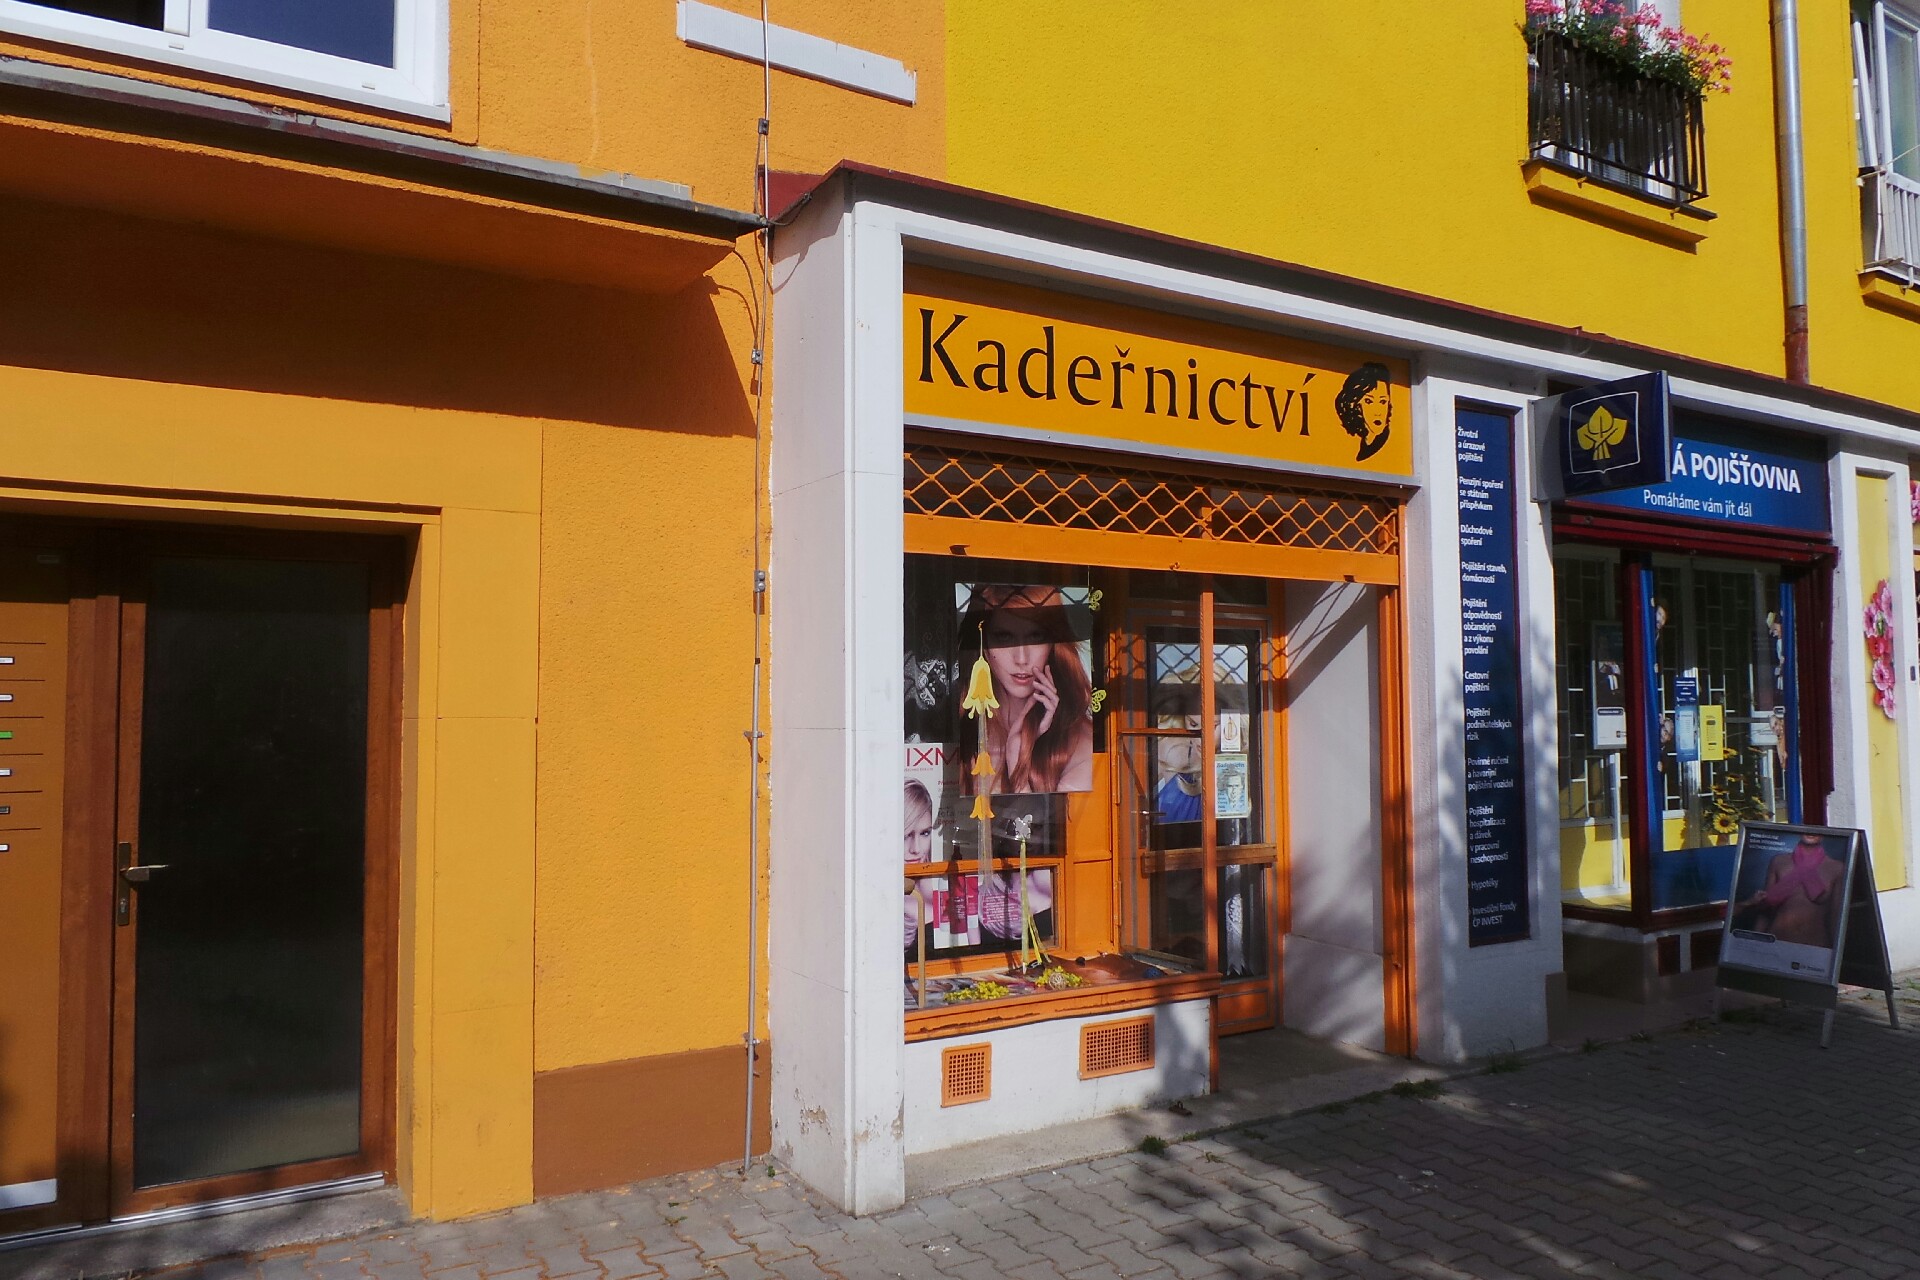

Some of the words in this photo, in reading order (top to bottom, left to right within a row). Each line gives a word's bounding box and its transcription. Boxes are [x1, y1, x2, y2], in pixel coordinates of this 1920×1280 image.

[917, 307, 1316, 437] Kadeřnictví
[1457, 425, 1479, 439] Životní
[1457, 441, 1462, 449] a
[1463, 439, 1486, 451] úrazové
[1458, 452, 1484, 463] pojištění
[1690, 452, 1802, 494] POJIŠŤOVNA
[1459, 476, 1482, 488] Penzijní
[1482, 479, 1504, 489] spoření
[1467, 489, 1489, 499] státním
[1459, 499, 1493, 511] příspěvkem
[1643, 489, 1700, 511] Pomáháme
[1702, 497, 1723, 514] vám
[1725, 499, 1736, 518] jít
[1738, 502, 1752, 517] dál
[1460, 524, 1494, 536] Důchodové
[1460, 536, 1483, 546] spoření
[1461, 561, 1486, 572] Pojištění
[1463, 597, 1488, 609] Pojištění
[1463, 621, 1497, 633] občanských
[1464, 635, 1468, 643] a
[1473, 633, 1494, 644] výkonu
[1464, 645, 1489, 656] povolání
[1464, 670, 1490, 680] Cestovní
[1465, 682, 1490, 693] pojištění
[1466, 707, 1491, 718] Pojištění
[1466, 719, 1512, 730] podnikatelských
[1466, 731, 1479, 741] rizik
[1467, 756, 1491, 766] Povinné
[1491, 755, 1509, 765] ručení
[1472, 768, 1497, 778] havarijní
[1467, 780, 1493, 792] pojištění
[1493, 778, 1514, 788] vozidel
[1468, 804, 1494, 816] Pojištění
[1469, 817, 1506, 828] hospitalizace
[1474, 829, 1491, 839] dávek
[1474, 840, 1500, 853] pracovní
[1471, 877, 1499, 891] Hypotéky
[1499, 901, 1517, 912] fondy
[1481, 914, 1503, 926] INVEST
